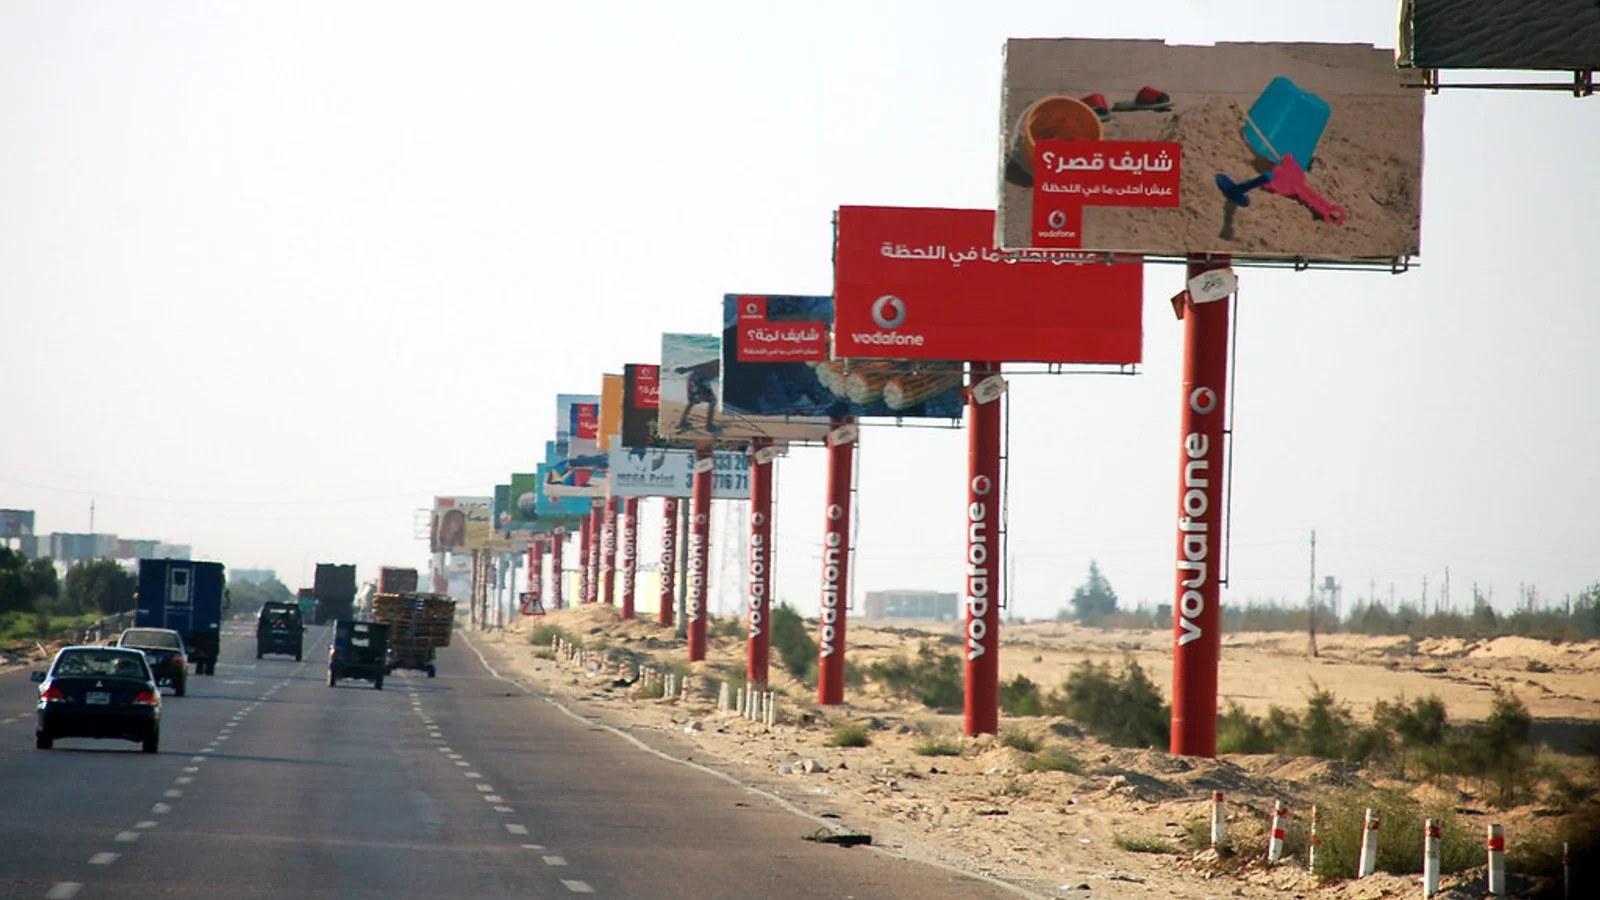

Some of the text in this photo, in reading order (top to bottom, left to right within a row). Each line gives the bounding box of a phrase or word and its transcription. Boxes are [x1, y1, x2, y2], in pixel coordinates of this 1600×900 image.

[1042, 150, 1173, 175] شايف قصر؟
[1041, 182, 1080, 194] اللحظة
[1082, 185, 1100, 198] في
[1101, 184, 1114, 194] ما
[1144, 184, 1172, 196] عيش
[1038, 230, 1075, 238] vodafone
[880, 241, 946, 260] اللحظة
[949, 246, 979, 267] في
[780, 326, 819, 344] شايف
[852, 331, 924, 346] vodafone
[688, 533, 703, 623] vodafone
[748, 533, 764, 639] vodafone
[820, 531, 841, 658] vodafone
